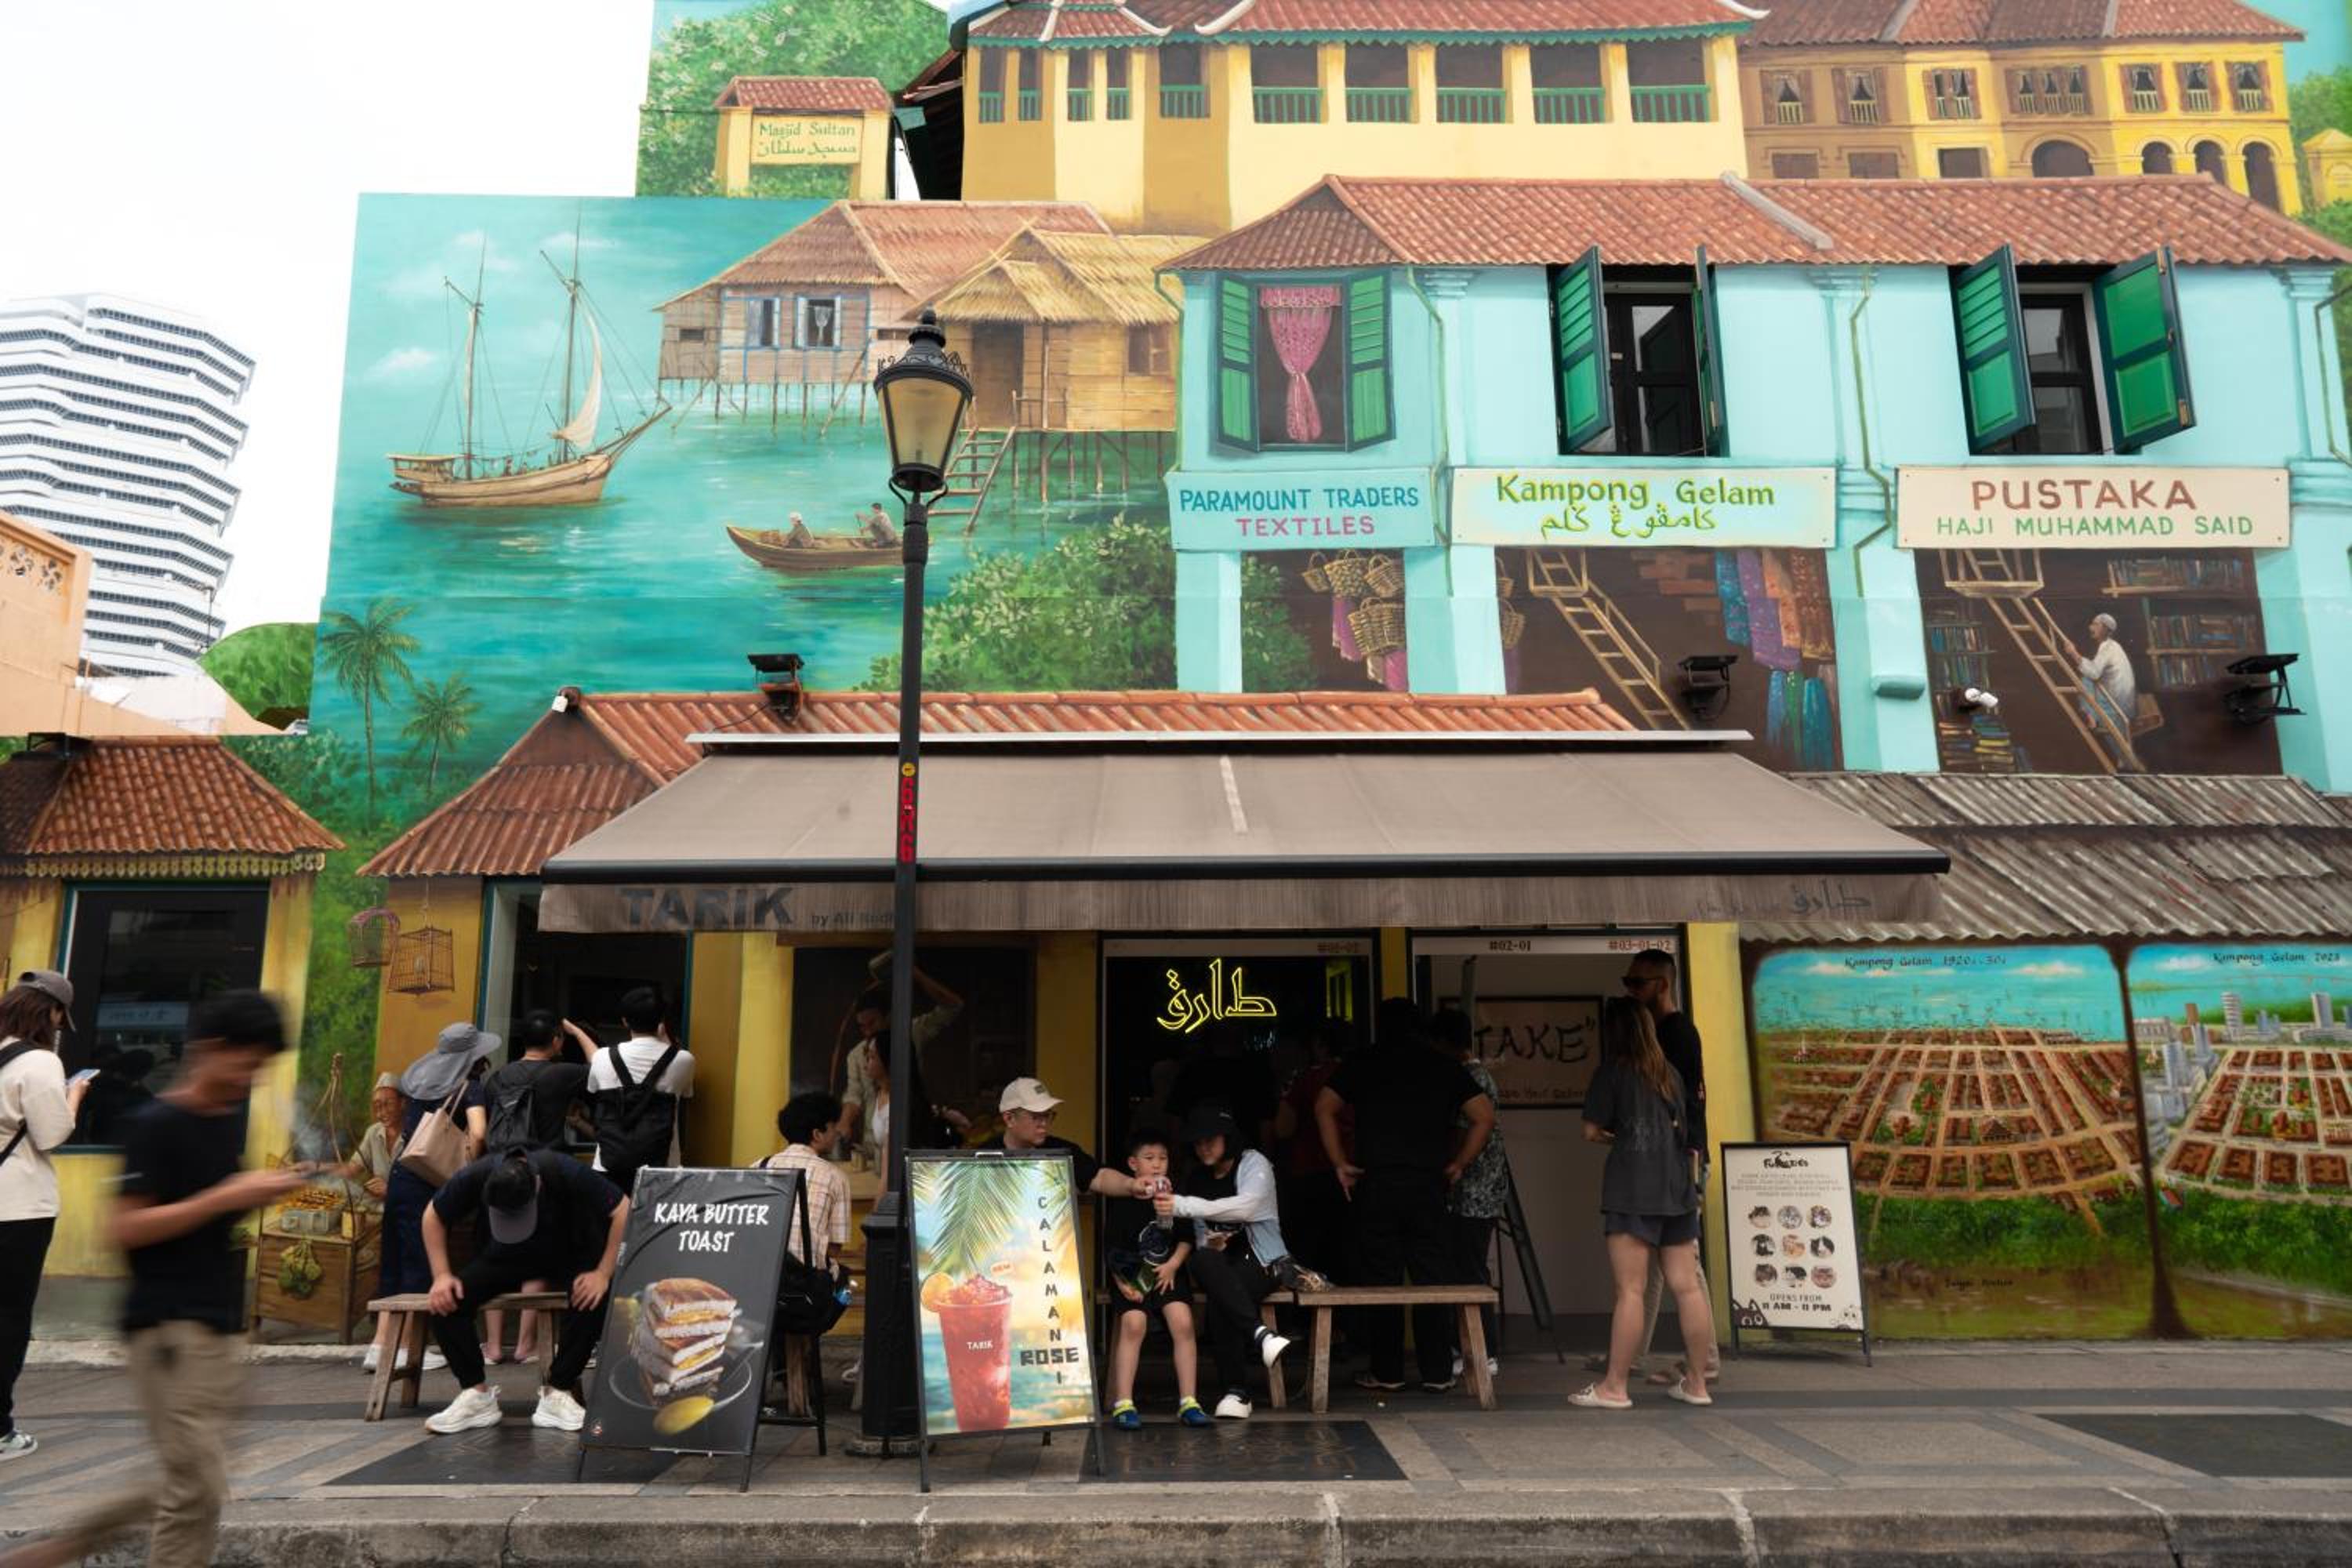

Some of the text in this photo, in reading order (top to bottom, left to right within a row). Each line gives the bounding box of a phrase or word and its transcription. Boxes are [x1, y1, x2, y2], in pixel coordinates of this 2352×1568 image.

[759, 122, 855, 139] Masjid Sultan
[1179, 487, 1419, 512] PARAMOUNT TRADERS
[1496, 474, 1776, 510] Kampong Gelam
[1971, 479, 2198, 510] PUSTAKA
[1236, 516, 1375, 537] TEXTILES
[1936, 516, 2254, 535] HAJI MUHAMMAD SAID
[618, 888, 793, 927] TARIK
[1156, 957, 1278, 1034] طارق
[653, 1202, 770, 1225] KAYA BUTTER
[677, 1229, 735, 1253] TOAST
[1020, 1346, 1080, 1367] ROSE
